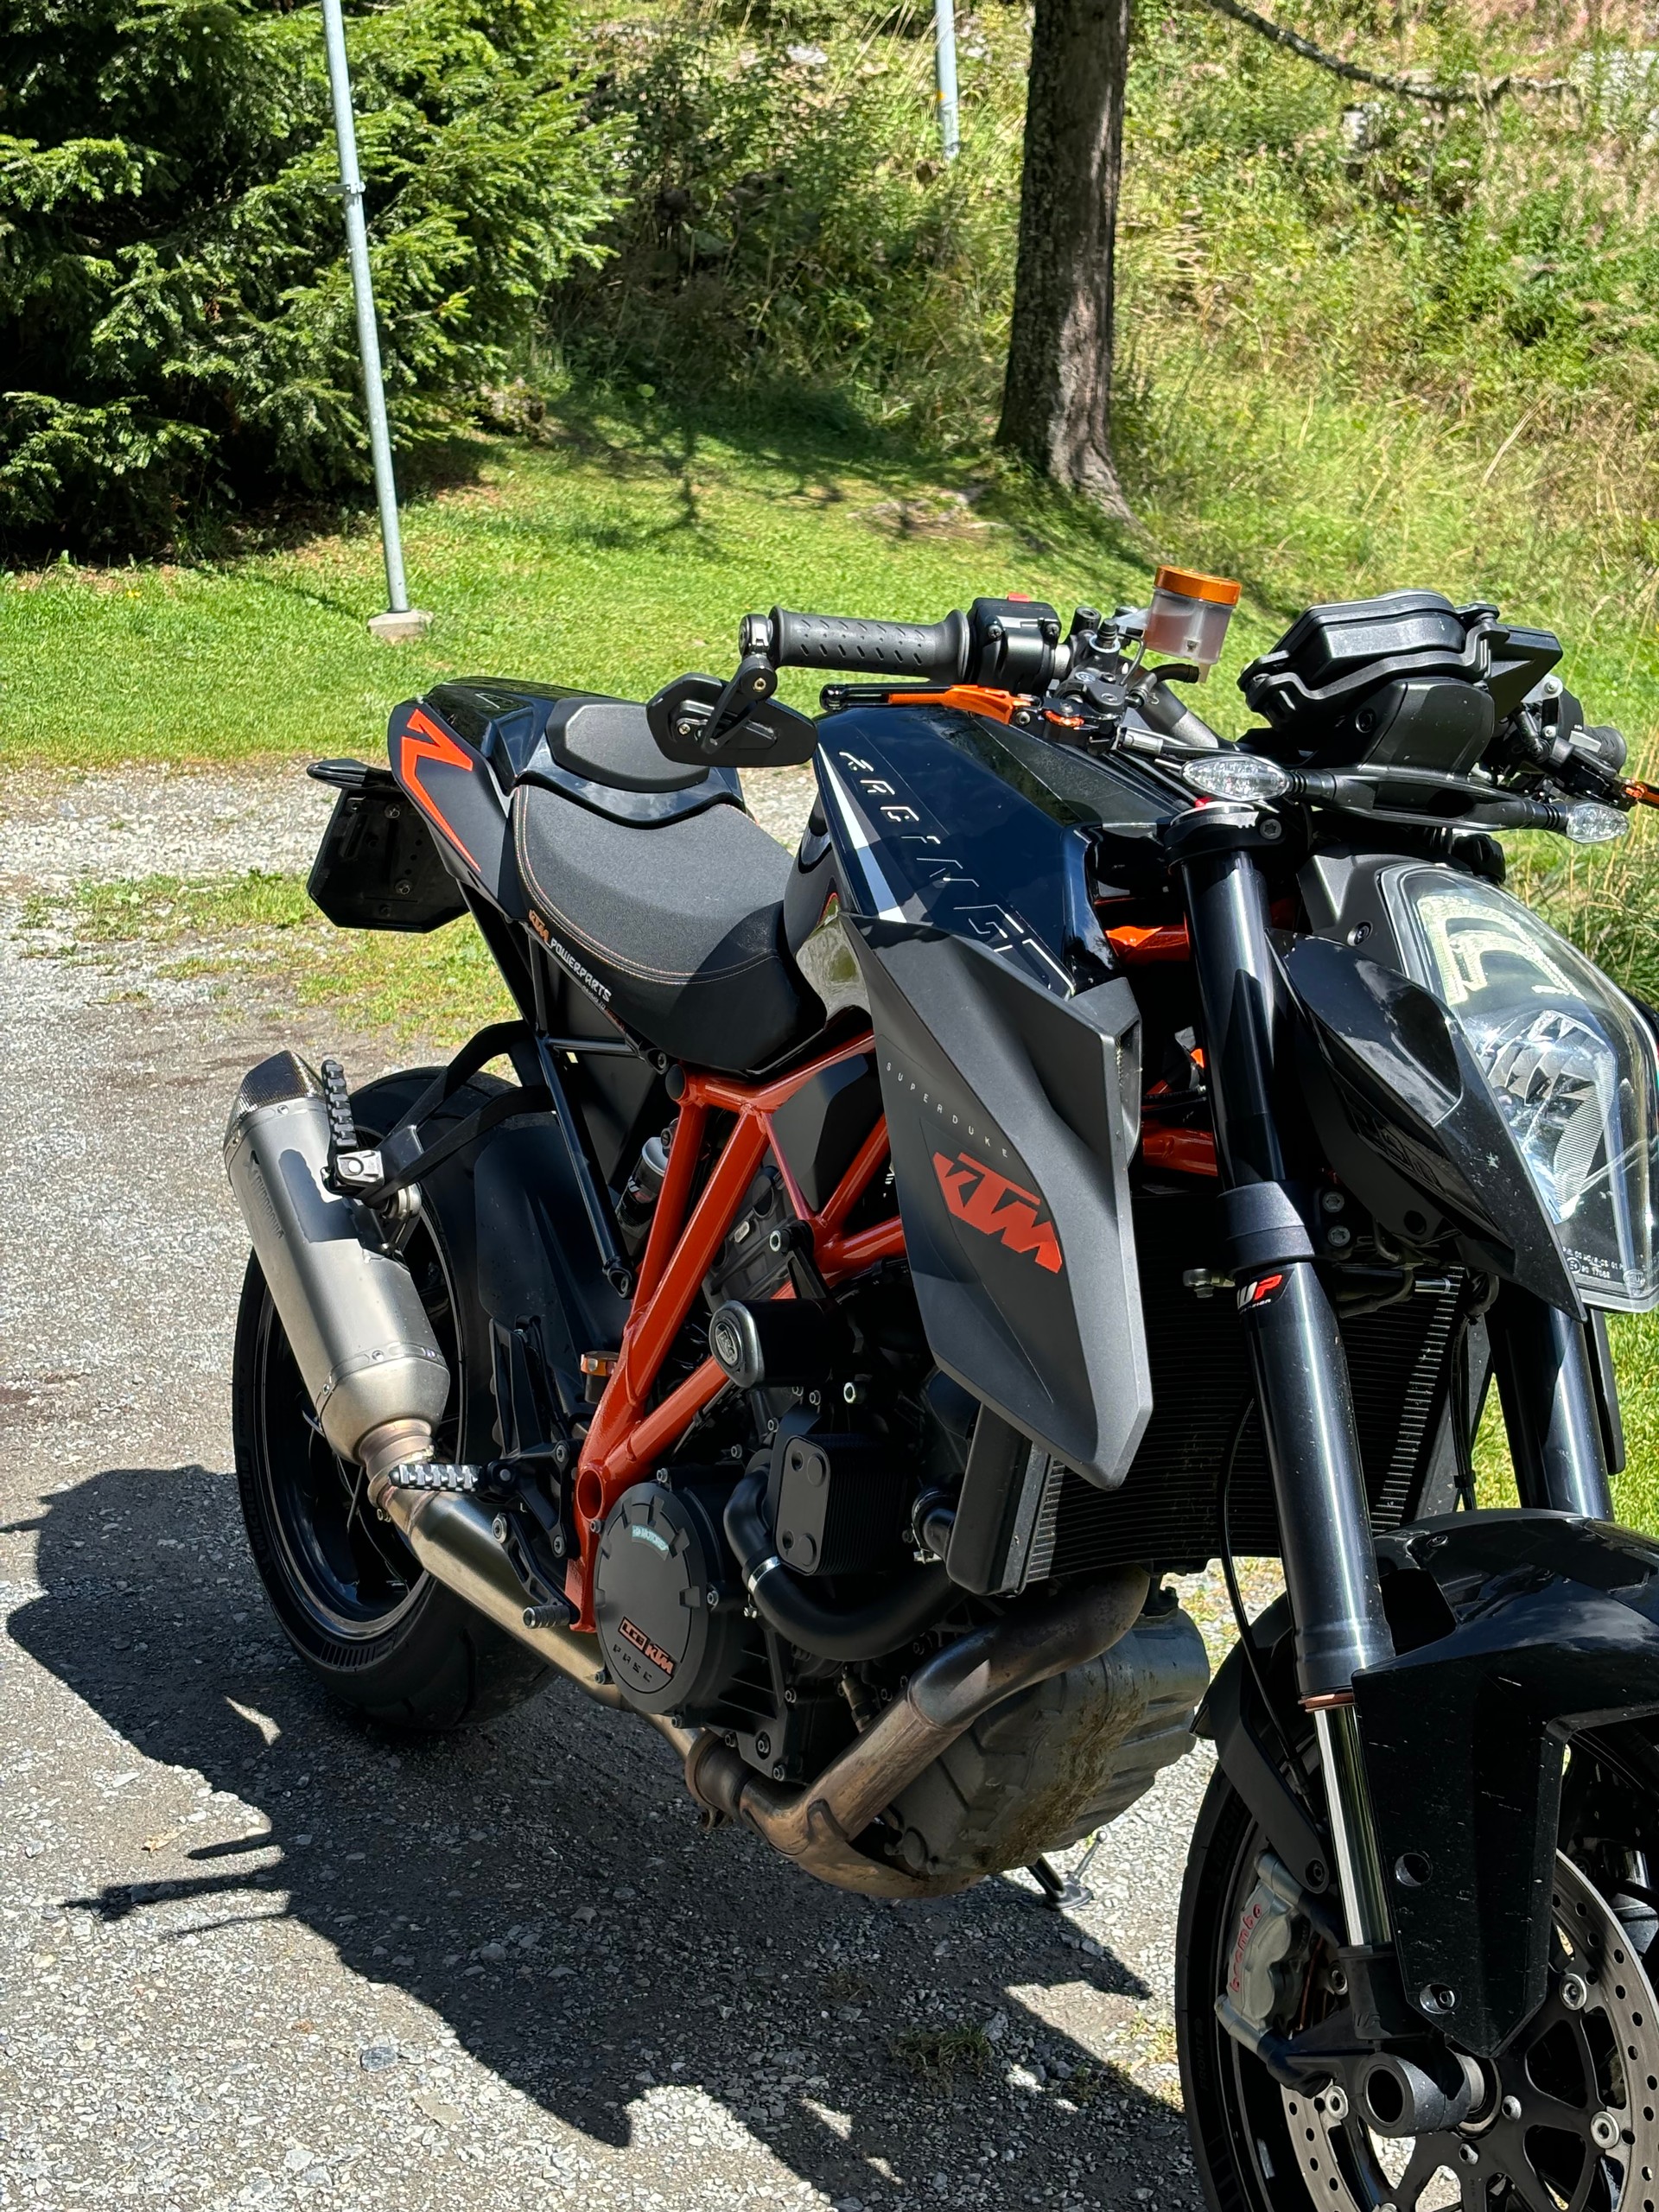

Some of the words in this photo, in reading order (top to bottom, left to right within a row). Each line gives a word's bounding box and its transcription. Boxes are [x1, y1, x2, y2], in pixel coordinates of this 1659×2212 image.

[528, 909, 550, 944] KTM
[550, 938, 612, 1002] POWERPARTS
[886, 1062, 1008, 1158] SUPERDUKE
[933, 1152, 1063, 1274] KTM
[644, 1644, 674, 1676] KTM
[1230, 1904, 1262, 1993] brembo
